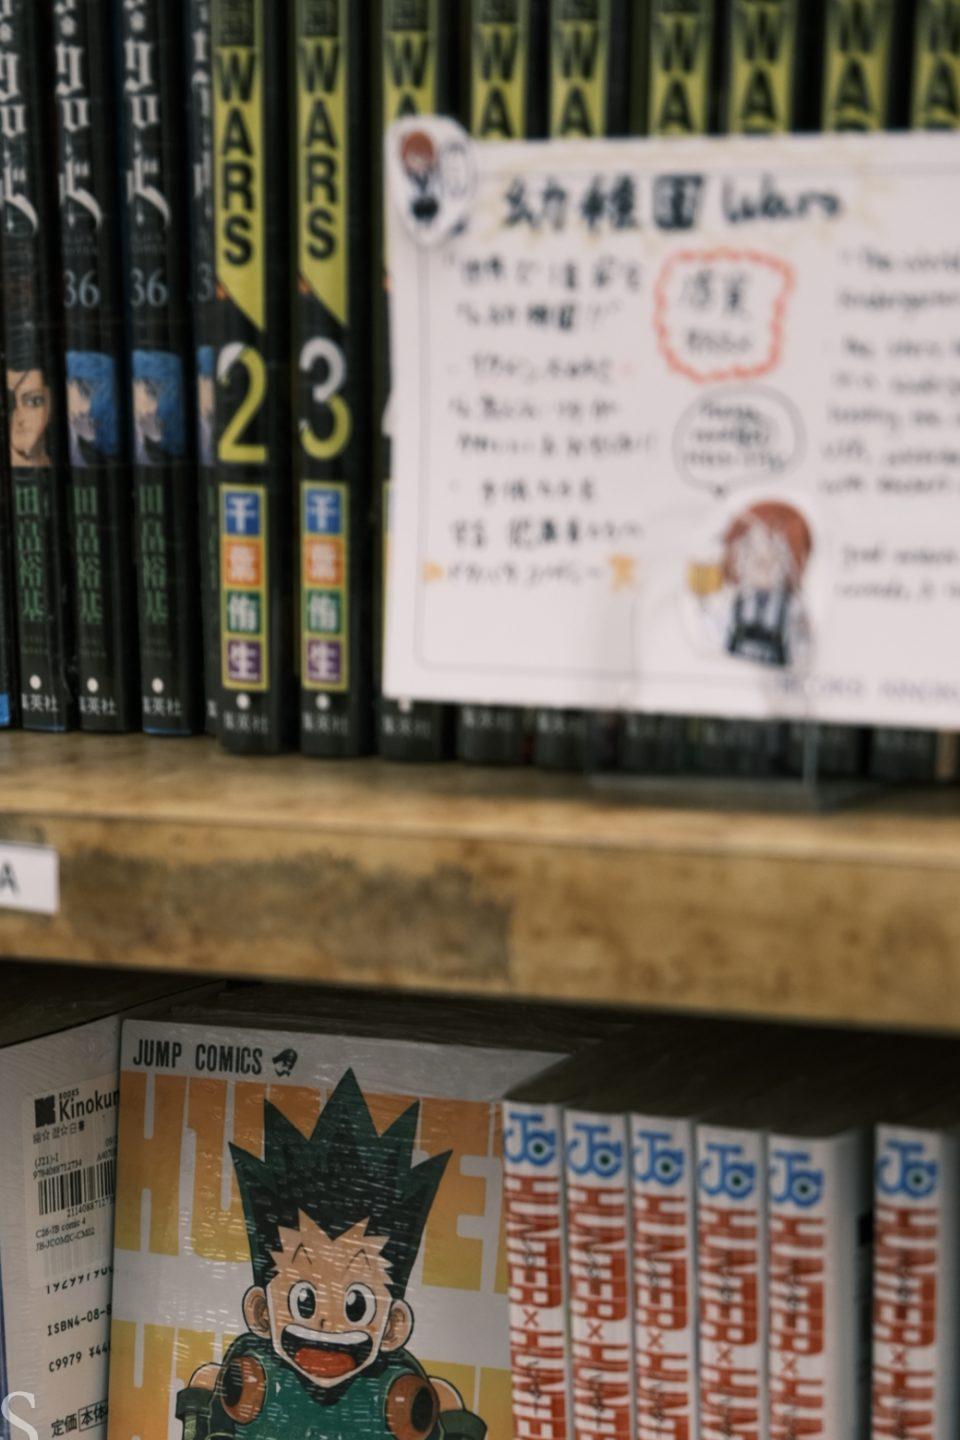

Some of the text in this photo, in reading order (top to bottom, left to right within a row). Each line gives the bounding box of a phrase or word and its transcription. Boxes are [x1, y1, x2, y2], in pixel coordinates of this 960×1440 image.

[215, 50, 254, 267] WARS
[299, 37, 340, 260] WARS
[216, 341, 267, 464] 2
[299, 336, 352, 460] 3
[132, 1038, 264, 1075] JUMP COMICS
